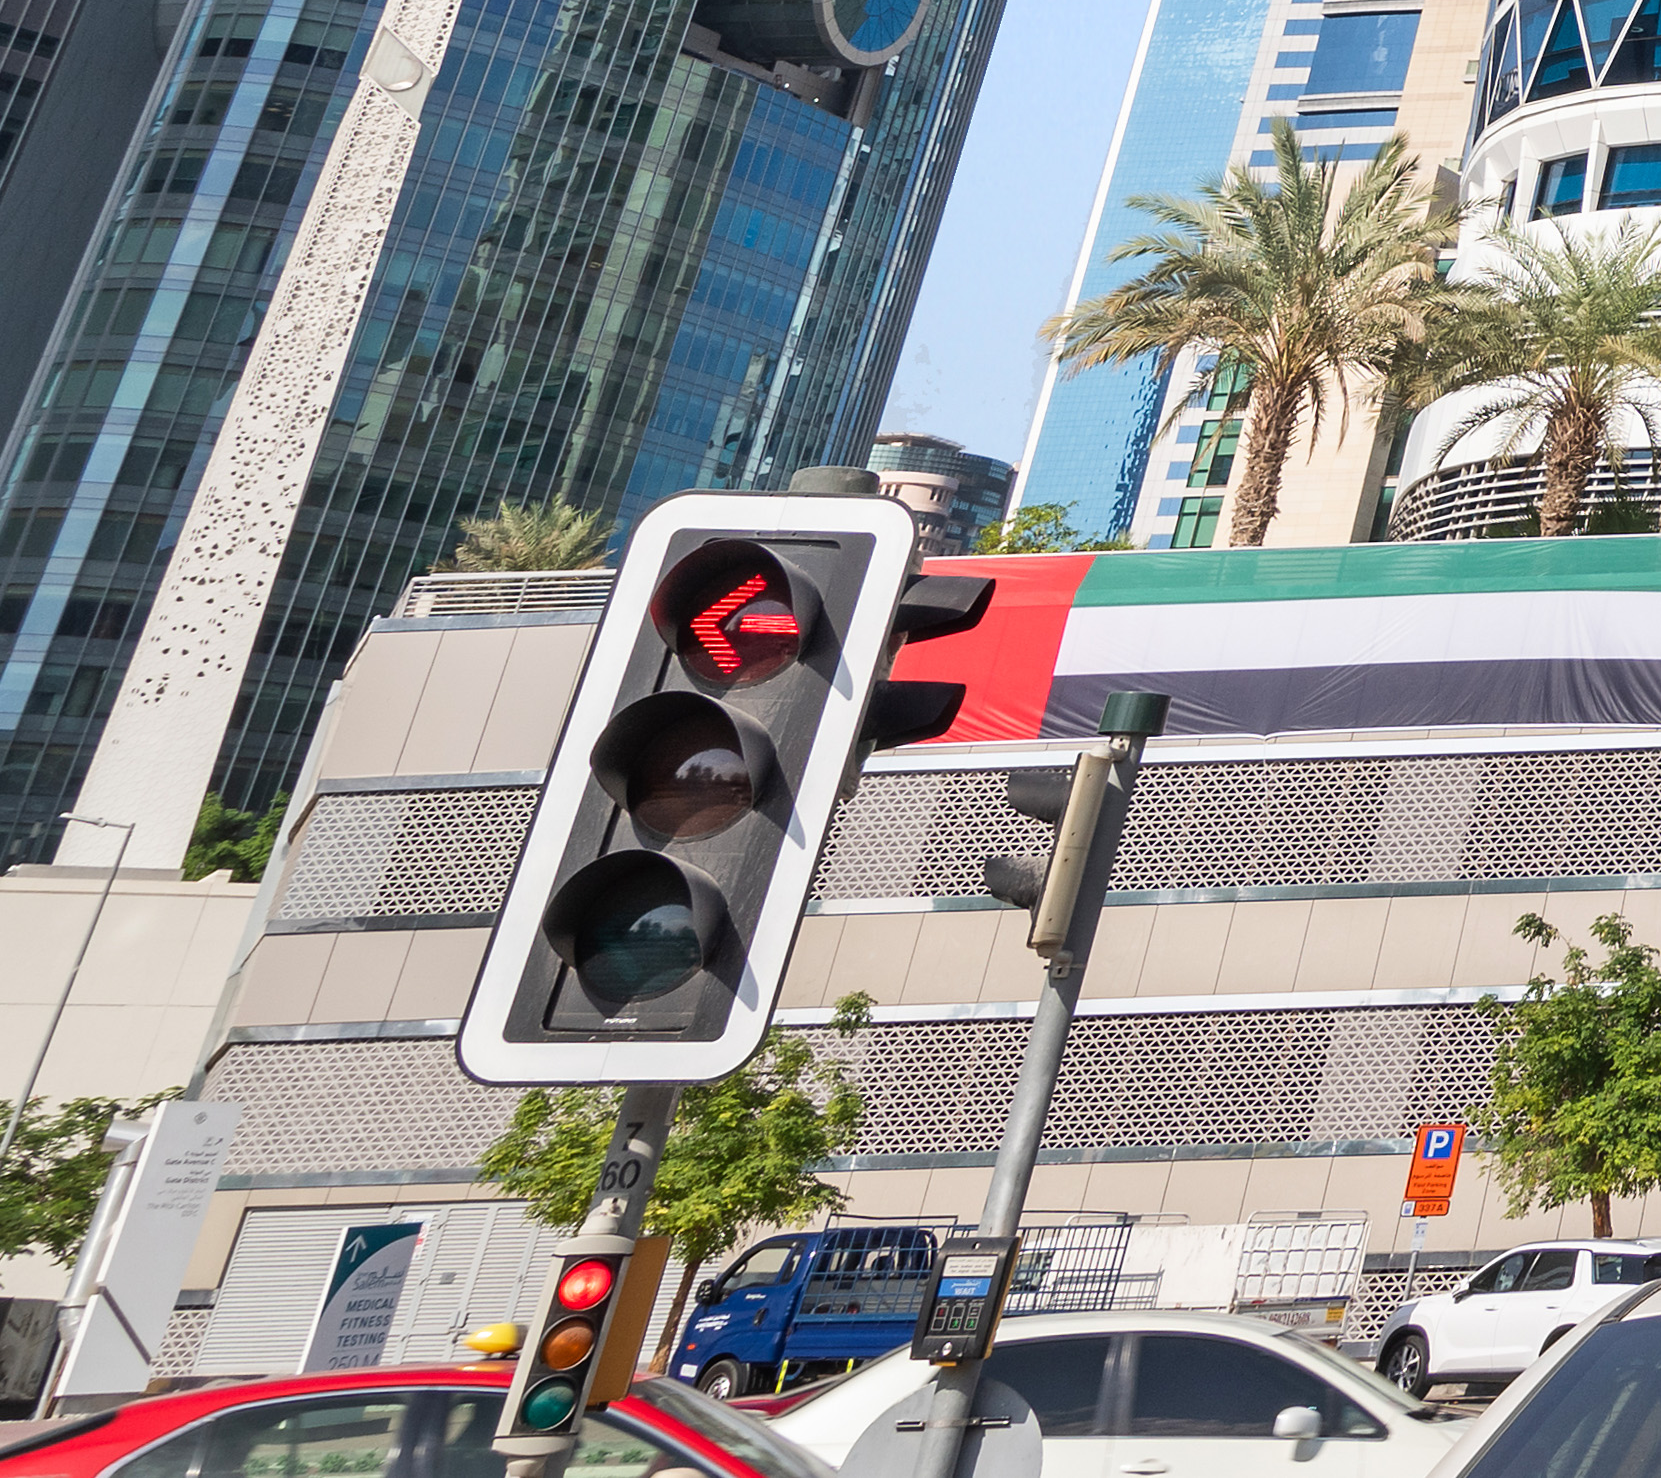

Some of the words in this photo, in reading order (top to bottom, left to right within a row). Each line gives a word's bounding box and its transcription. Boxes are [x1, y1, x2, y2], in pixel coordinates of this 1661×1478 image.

[165, 1176, 181, 1184] Gate
[183, 1176, 209, 1184] District
[600, 1159, 642, 1192] 60
[1418, 1203, 1444, 1213] 337A
[954, 1287, 976, 1296] WAIT
[346, 1298, 394, 1312] MEDICAL
[340, 1314, 391, 1330] FITNESS
[336, 1331, 385, 1348] TESTING
